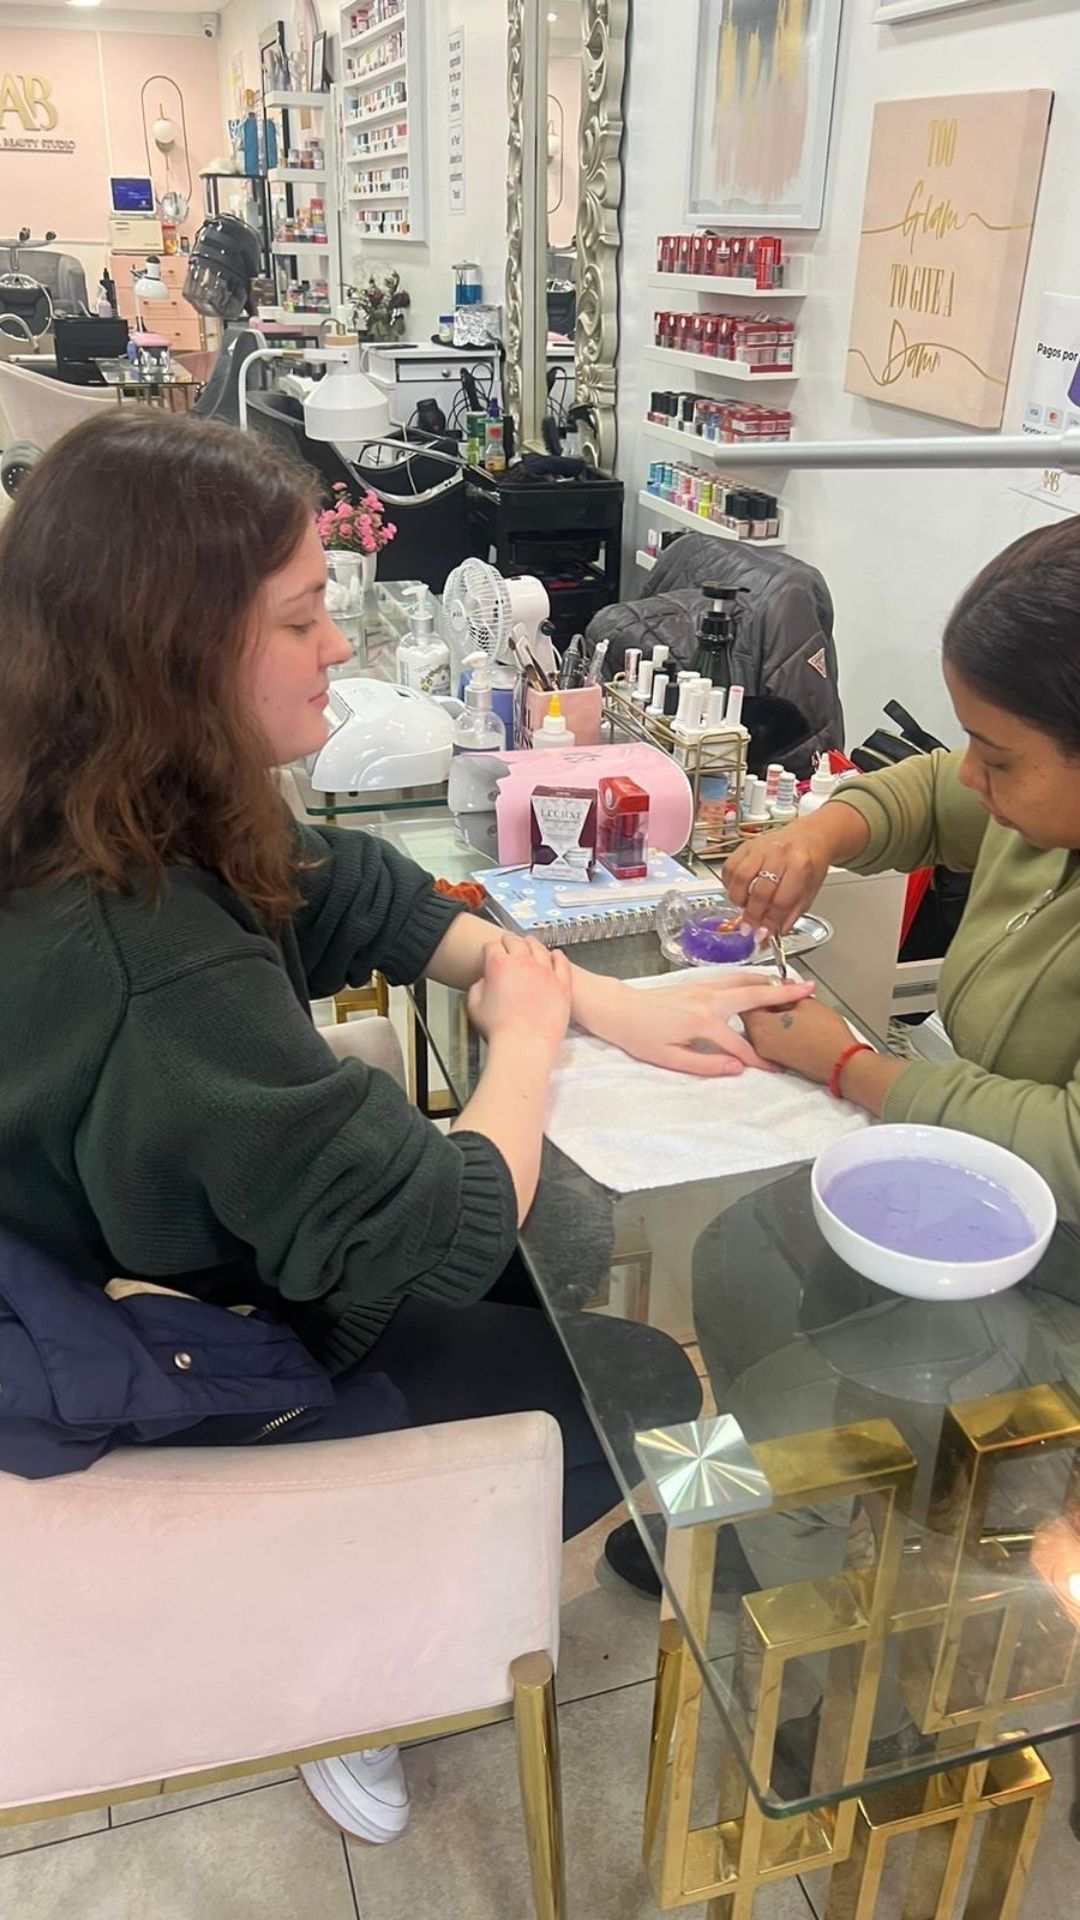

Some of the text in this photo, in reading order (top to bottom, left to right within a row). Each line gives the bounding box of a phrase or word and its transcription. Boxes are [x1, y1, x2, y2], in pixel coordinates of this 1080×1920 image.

[0, 72, 58, 132] AB
[926, 118, 958, 168] TOO
[902, 179, 962, 254] Glam
[889, 263, 955, 317] TO GIVE A
[882, 318, 941, 386] Damn
[1037, 342, 1078, 361] Pagos por
